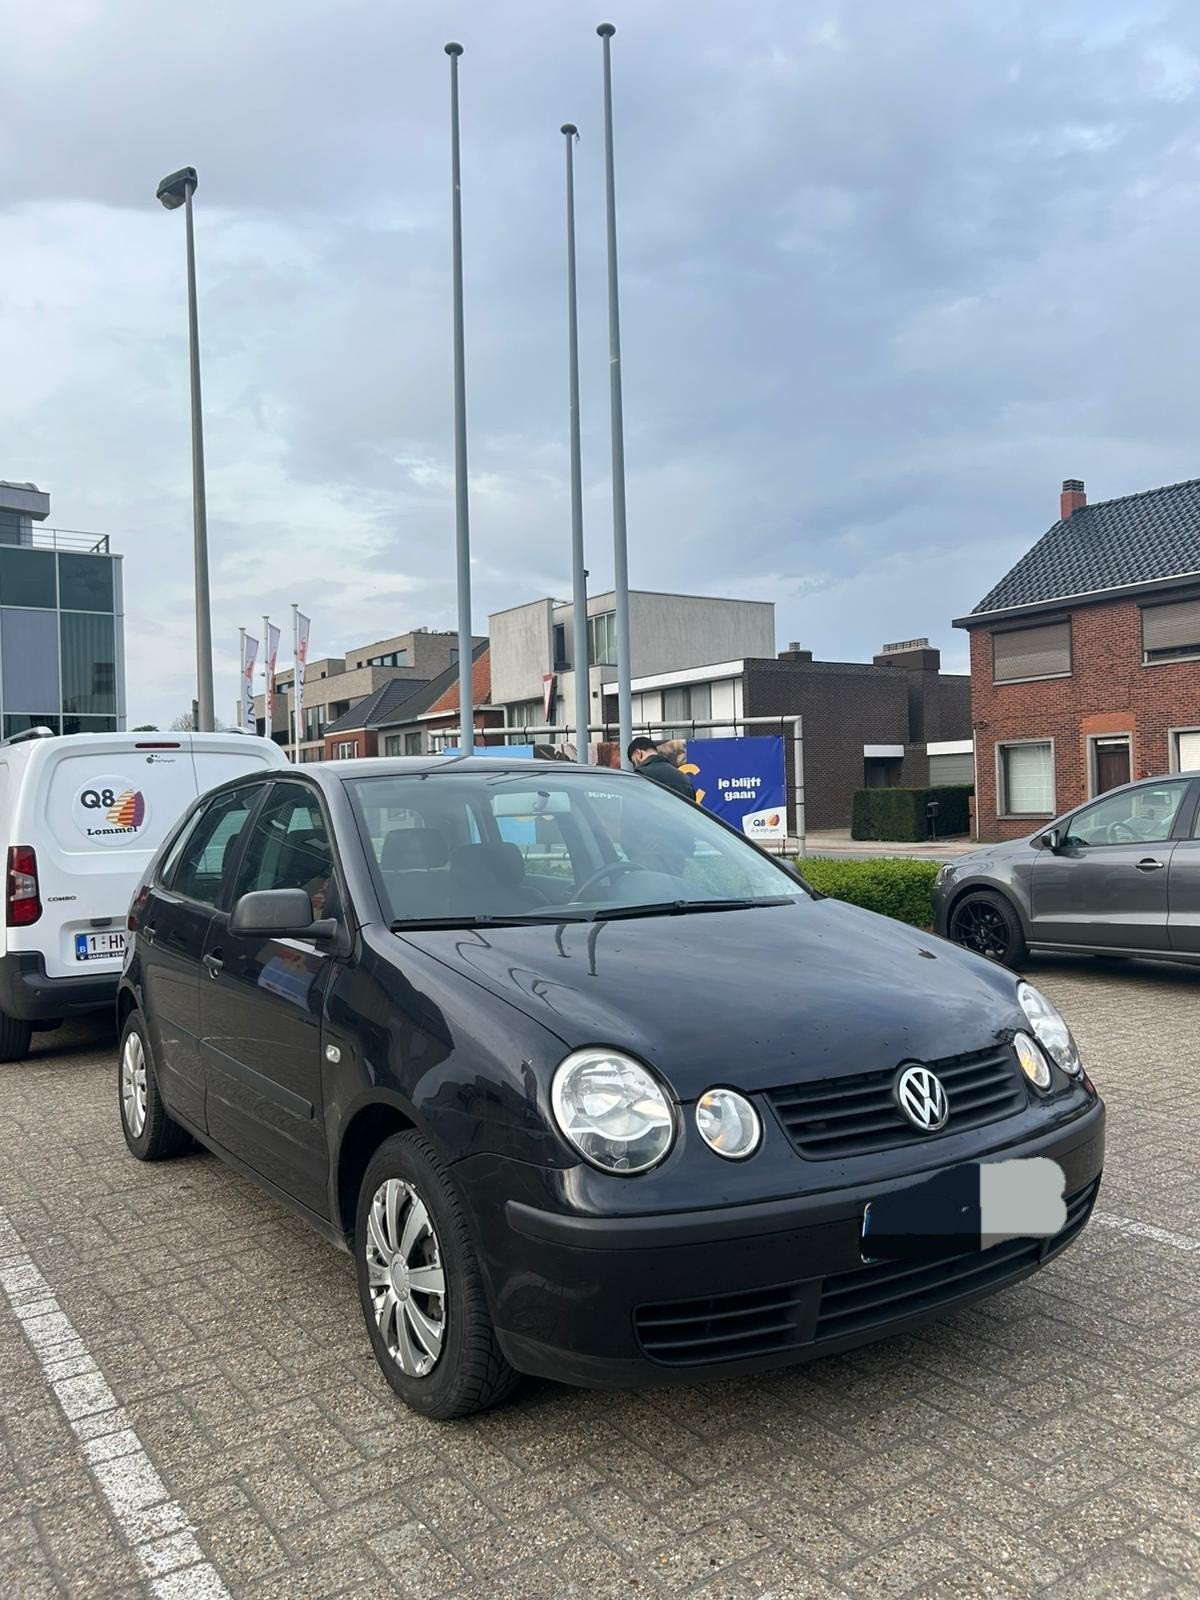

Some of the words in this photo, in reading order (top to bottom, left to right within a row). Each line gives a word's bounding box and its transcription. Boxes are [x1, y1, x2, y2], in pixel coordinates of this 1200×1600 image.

[718, 778, 729, 790] je
[731, 777, 761, 789] blijft
[80, 789, 116, 809] Q8
[724, 790, 756, 801] gaan
[753, 819, 766, 827] Q8
[87, 825, 138, 836] Lommel
[79, 945, 87, 953] B
